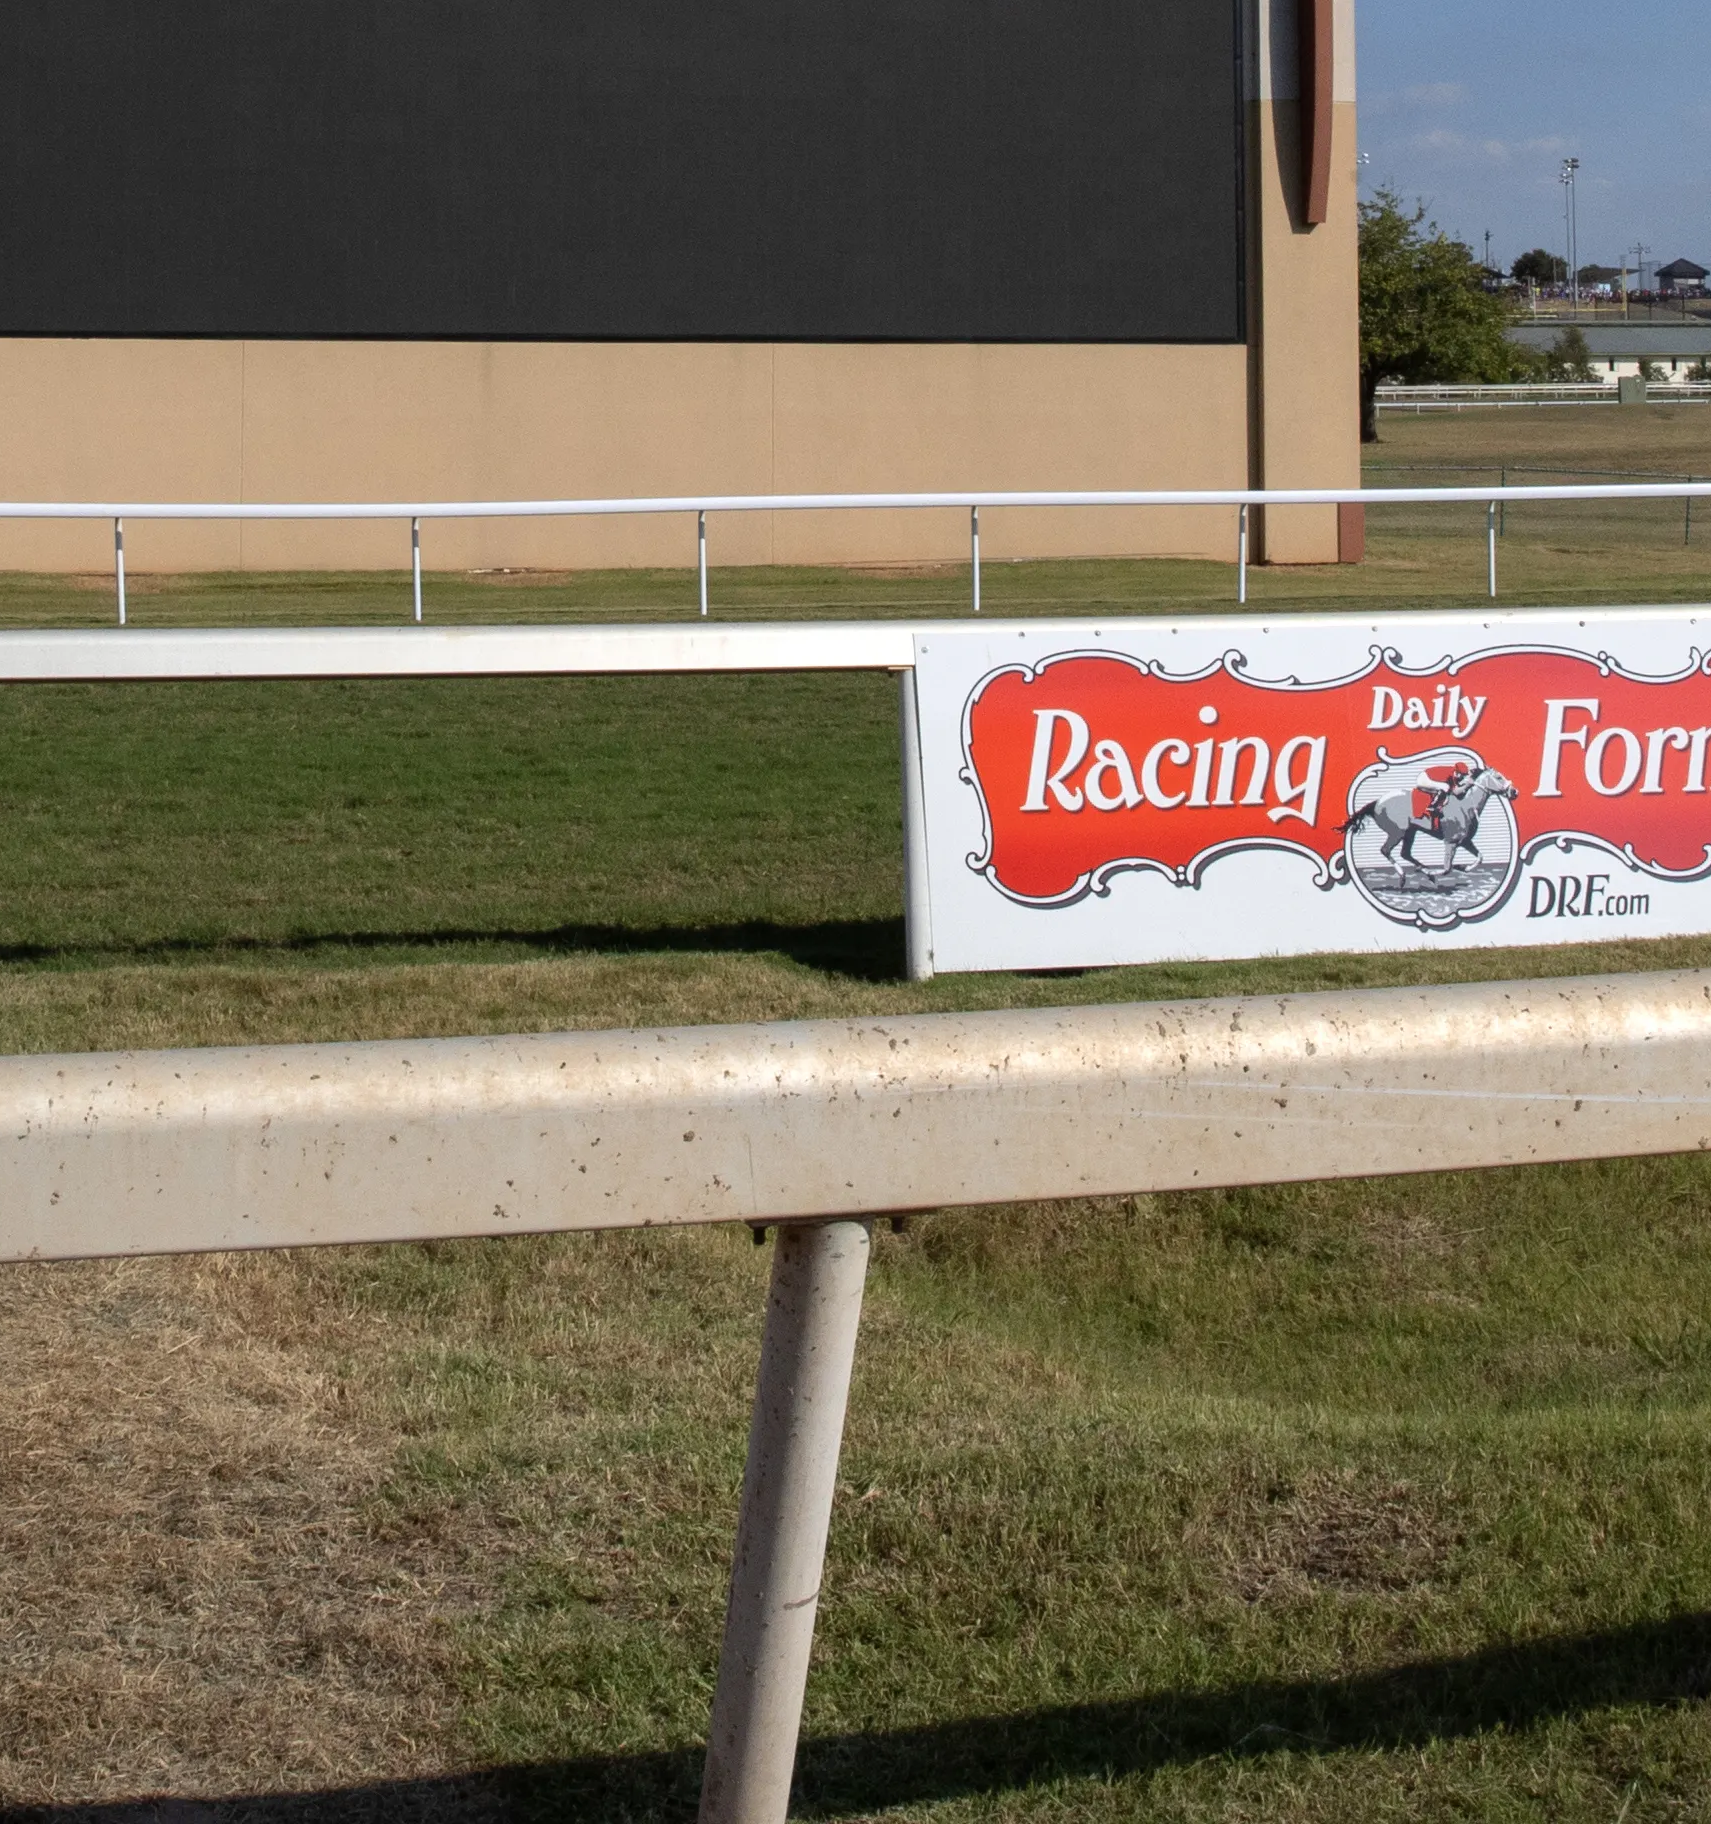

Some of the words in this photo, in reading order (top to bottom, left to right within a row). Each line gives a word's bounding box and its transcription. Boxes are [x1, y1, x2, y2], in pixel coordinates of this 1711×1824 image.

[1367, 685, 1488, 742] Daily
[1021, 705, 1327, 826] Racing
[1526, 873, 1650, 920] DRF.com
